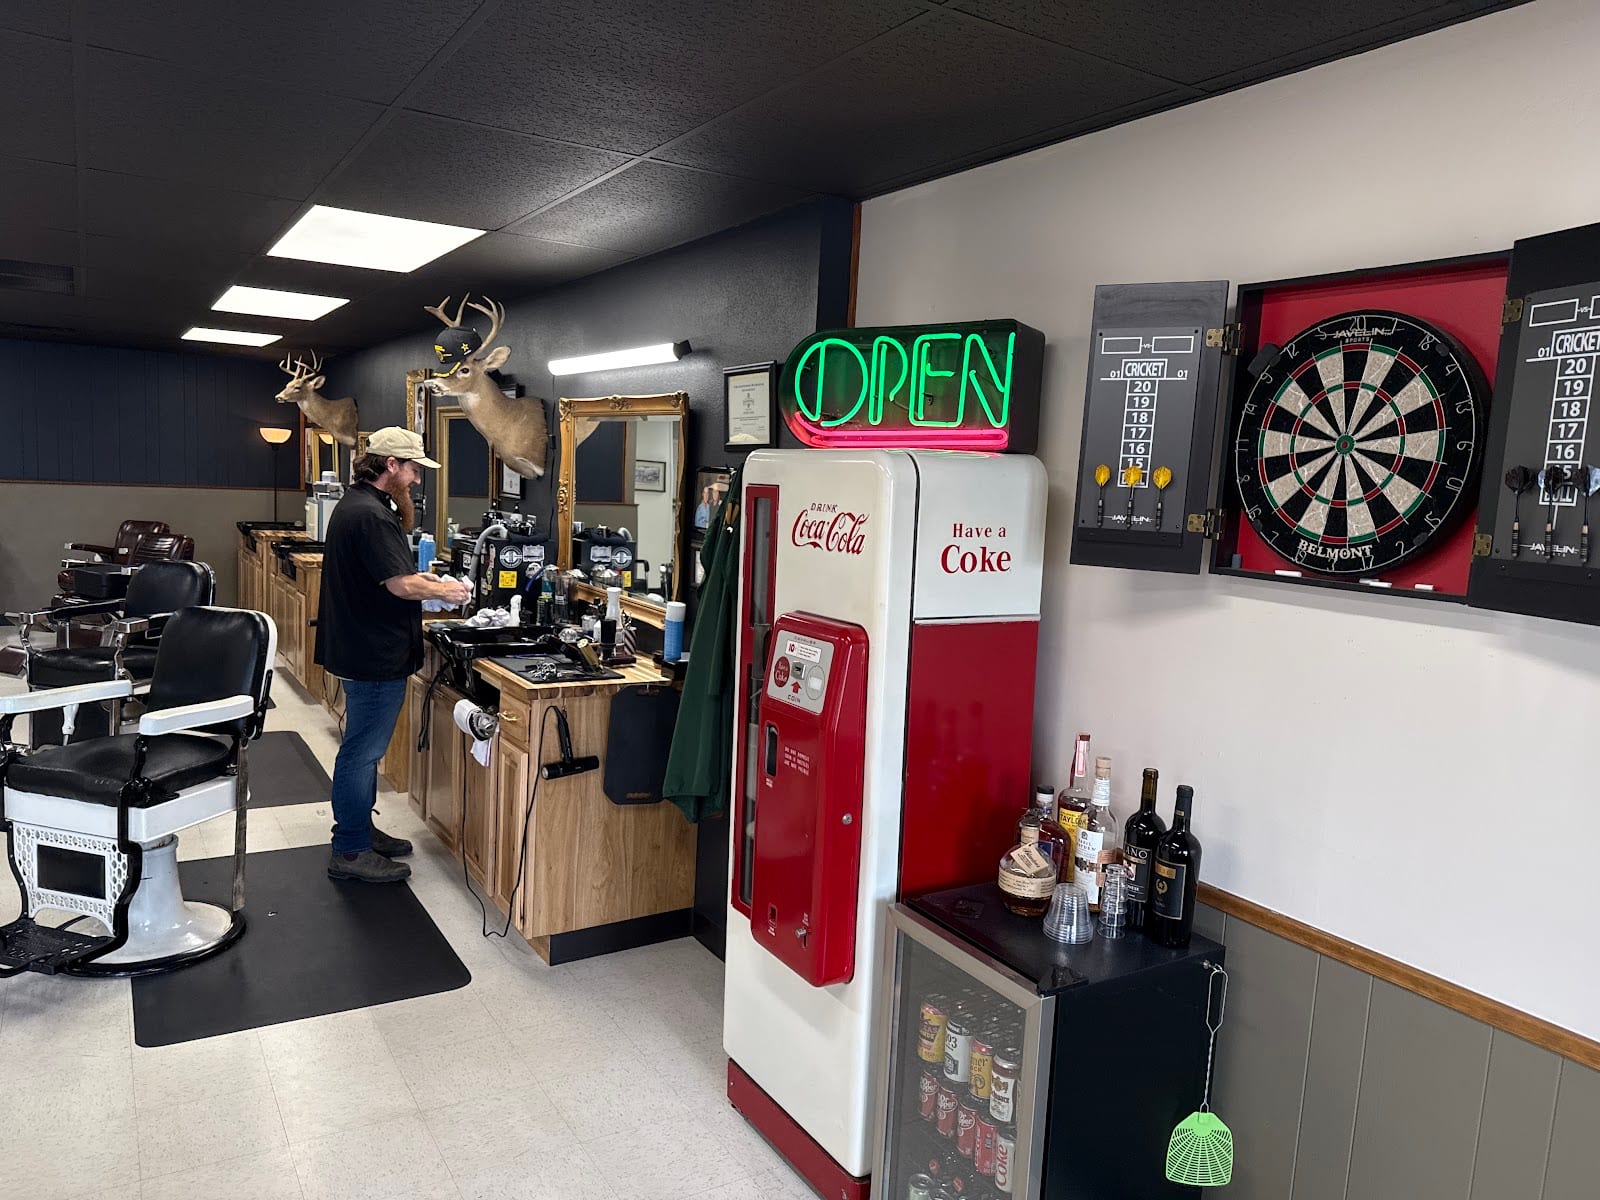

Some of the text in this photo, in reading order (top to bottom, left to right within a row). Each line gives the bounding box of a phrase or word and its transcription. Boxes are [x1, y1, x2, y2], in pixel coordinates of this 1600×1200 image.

[1333, 327, 1385, 338] JAVELIN
[1556, 332, 1600, 354] CRICKET
[1538, 347, 1550, 358] 01
[1110, 362, 1188, 378] 01 CRICKET 01
[1565, 358, 1587, 374] 20
[795, 332, 1016, 428] OPEN
[1133, 381, 1152, 393] 20
[1564, 380, 1584, 396] 19
[1133, 396, 1150, 408] 19
[1561, 401, 1581, 417] 18
[1131, 412, 1148, 423] 18
[1130, 427, 1147, 439] 17
[1558, 423, 1578, 439] 17
[1128, 443, 1145, 454] 16
[1555, 444, 1575, 460] 16
[1127, 458, 1143, 469] 15
[810, 502, 838, 513] DRINK
[953, 523, 1006, 538] Have a
[1298, 539, 1373, 559] BELMONT
[941, 544, 1011, 574] Coke
[995, 1143, 1008, 1186] Coke
